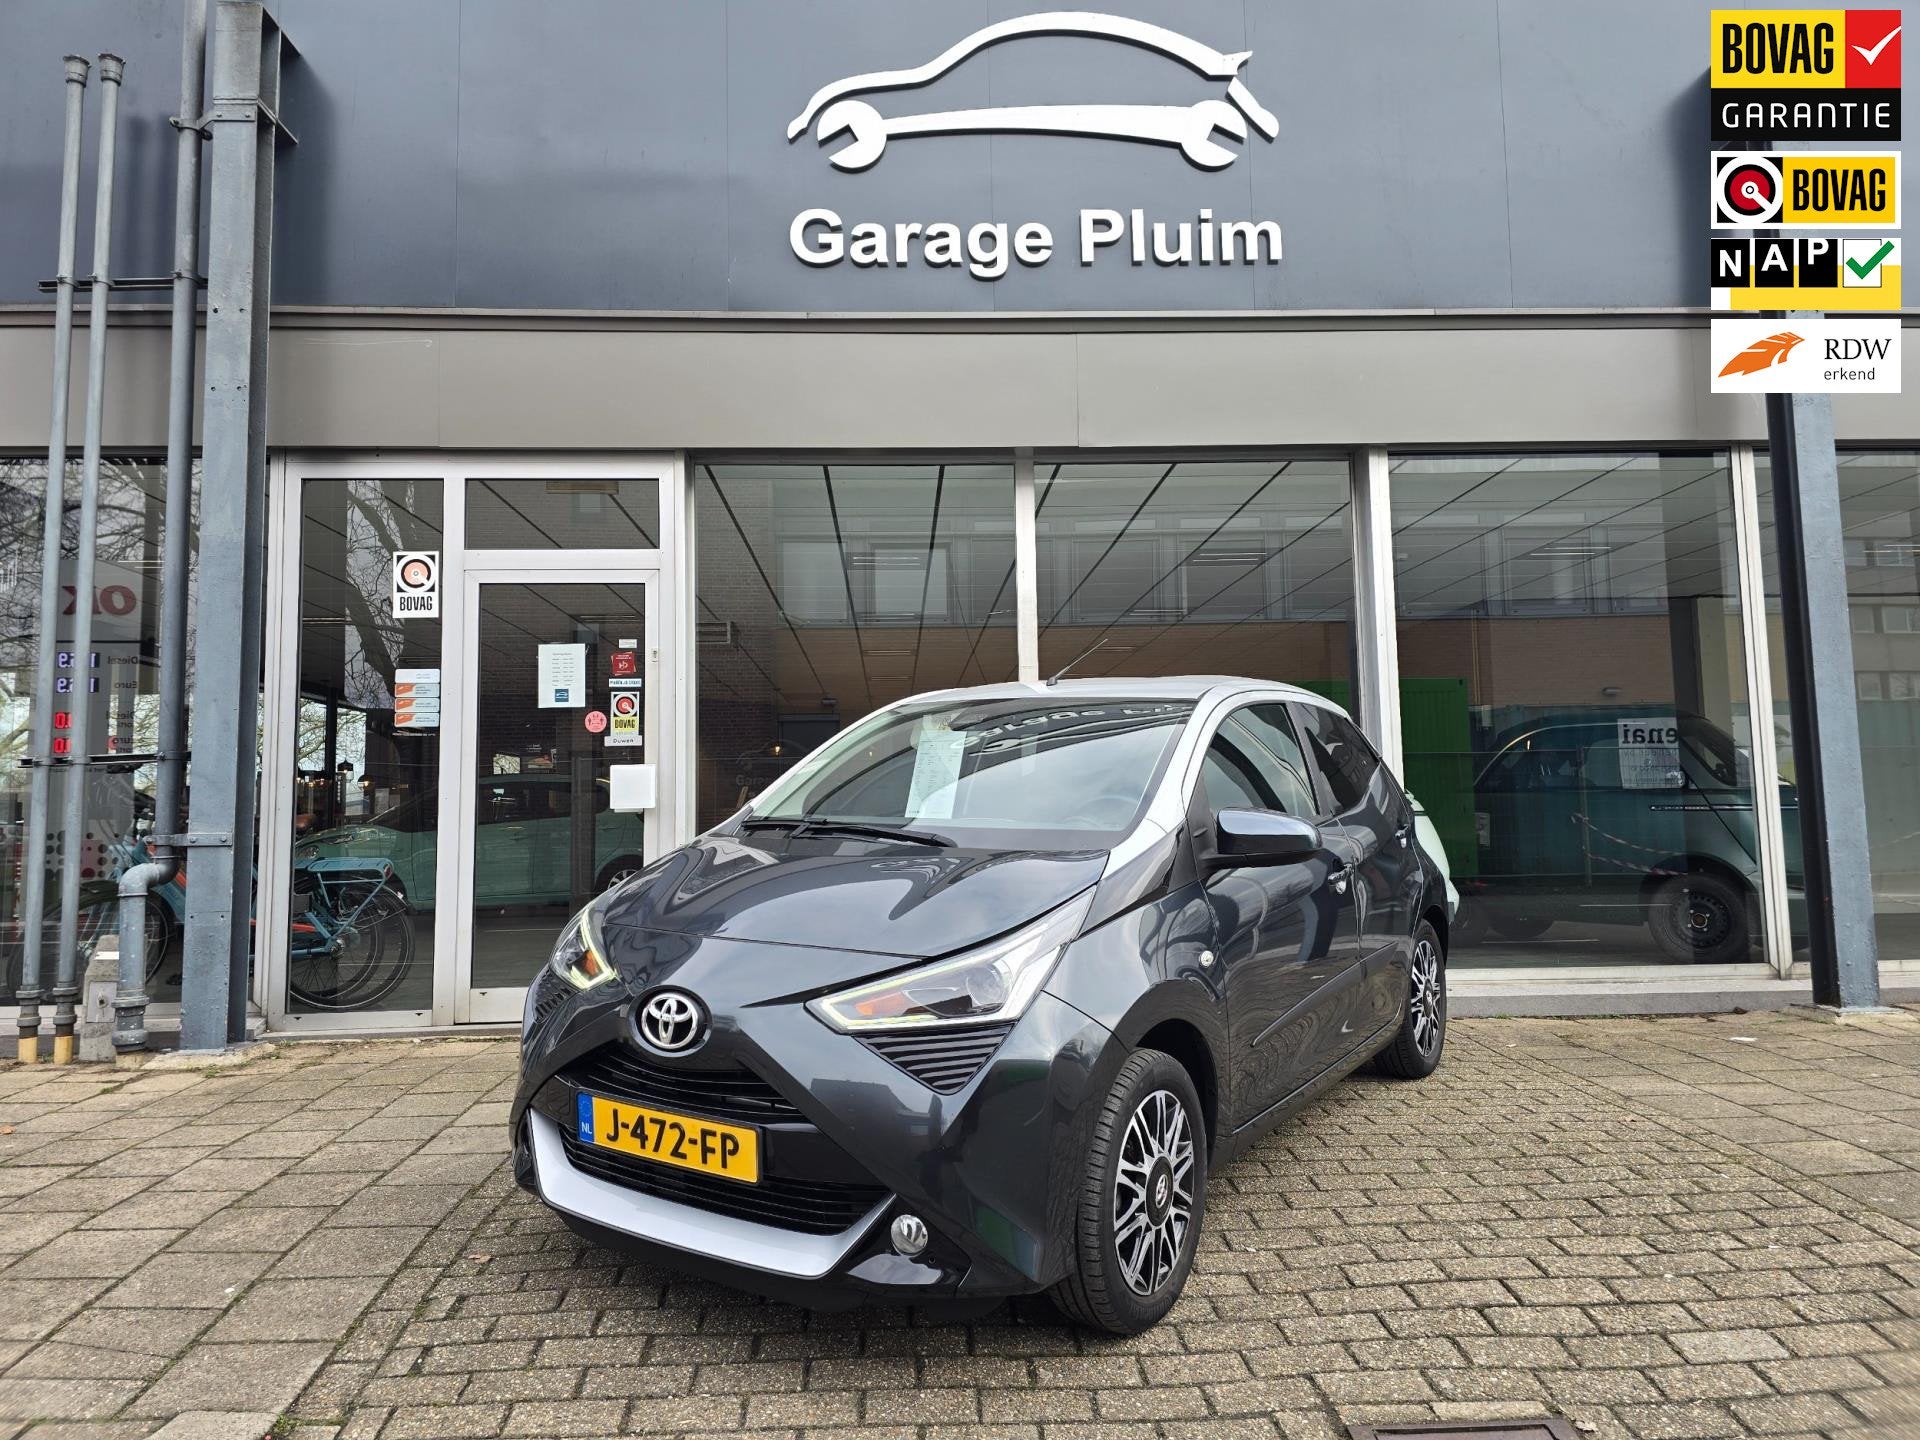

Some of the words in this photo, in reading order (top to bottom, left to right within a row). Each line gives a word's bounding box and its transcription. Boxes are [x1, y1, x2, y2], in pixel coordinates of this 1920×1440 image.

[789, 208, 1054, 281] Garage
[1080, 208, 1284, 266] Pluim
[399, 596, 433, 612] BOVAG
[614, 719, 636, 729] BOVAG
[581, 1123, 593, 1135] NL
[606, 1109, 739, 1169] J-472-FP
